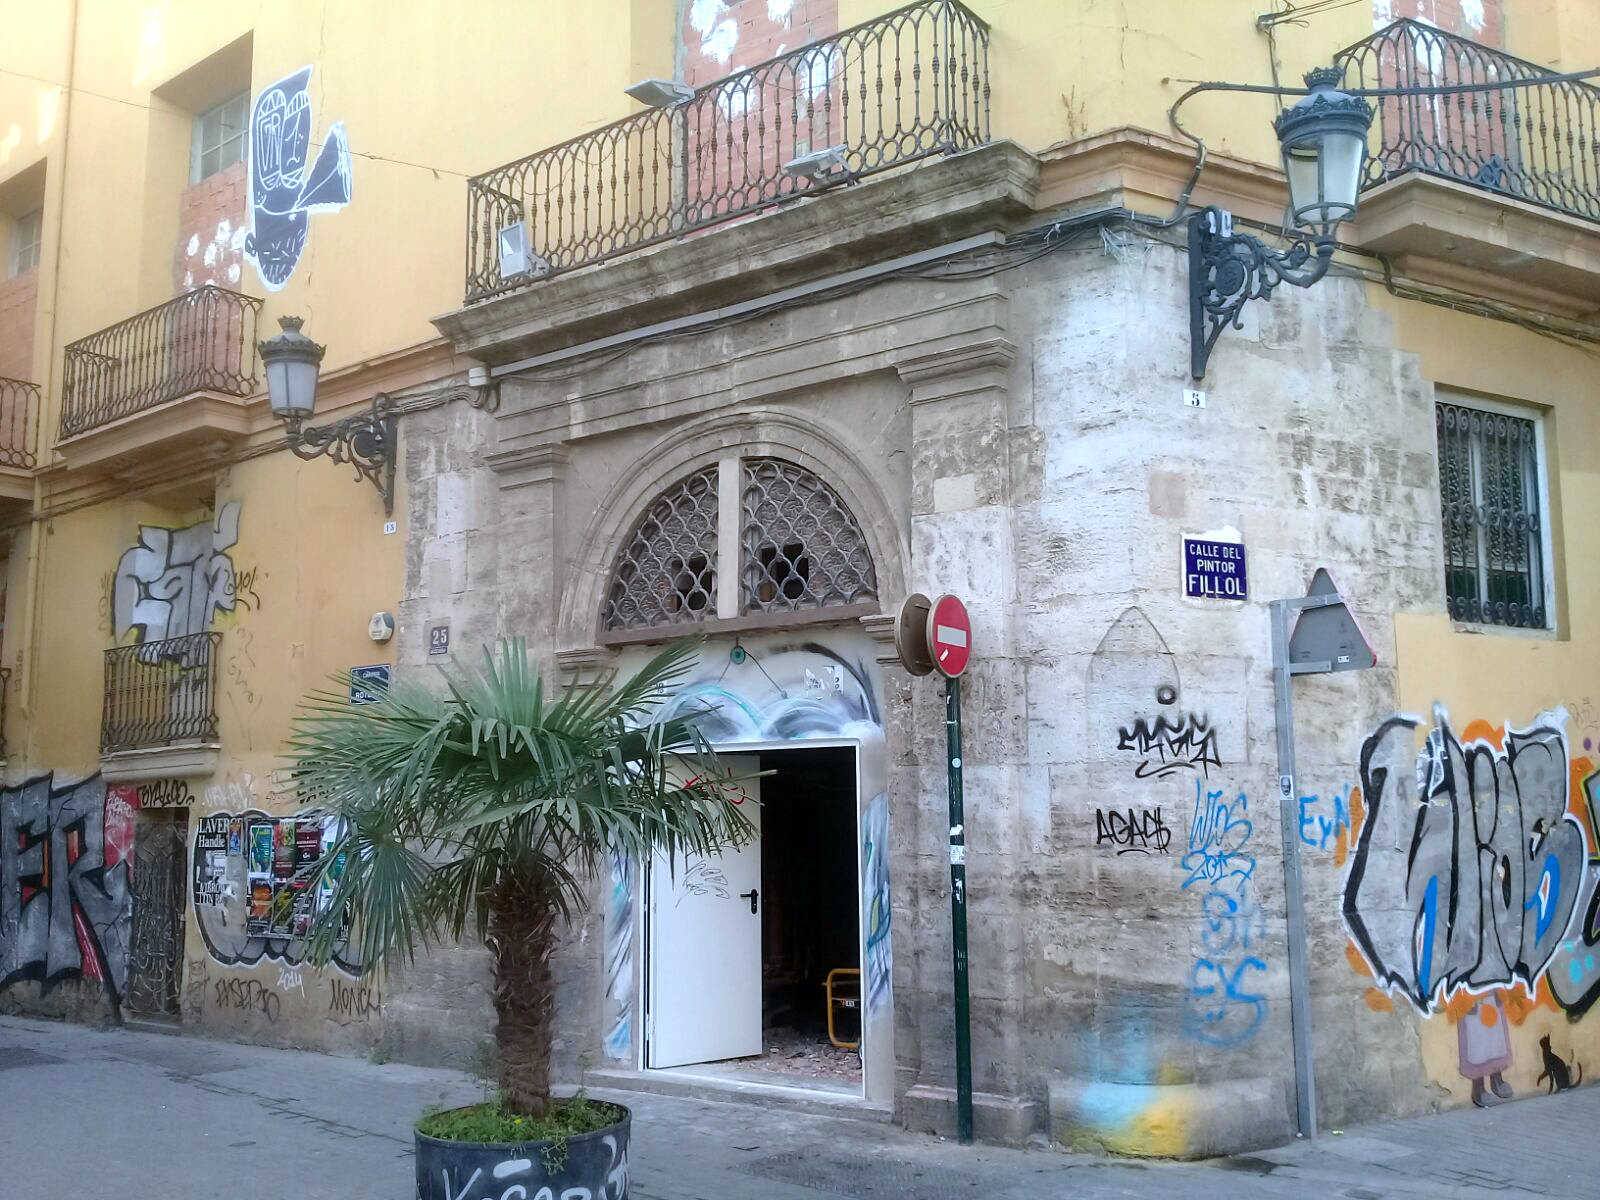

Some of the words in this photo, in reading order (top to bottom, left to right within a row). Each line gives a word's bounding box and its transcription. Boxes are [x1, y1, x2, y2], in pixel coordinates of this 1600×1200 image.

[1189, 543, 1219, 558] CALLE
[1222, 546, 1242, 560] DEL
[1196, 558, 1236, 574] PINTOR
[1188, 573, 1246, 596] FILLOL
[432, 629, 447, 645] 25
